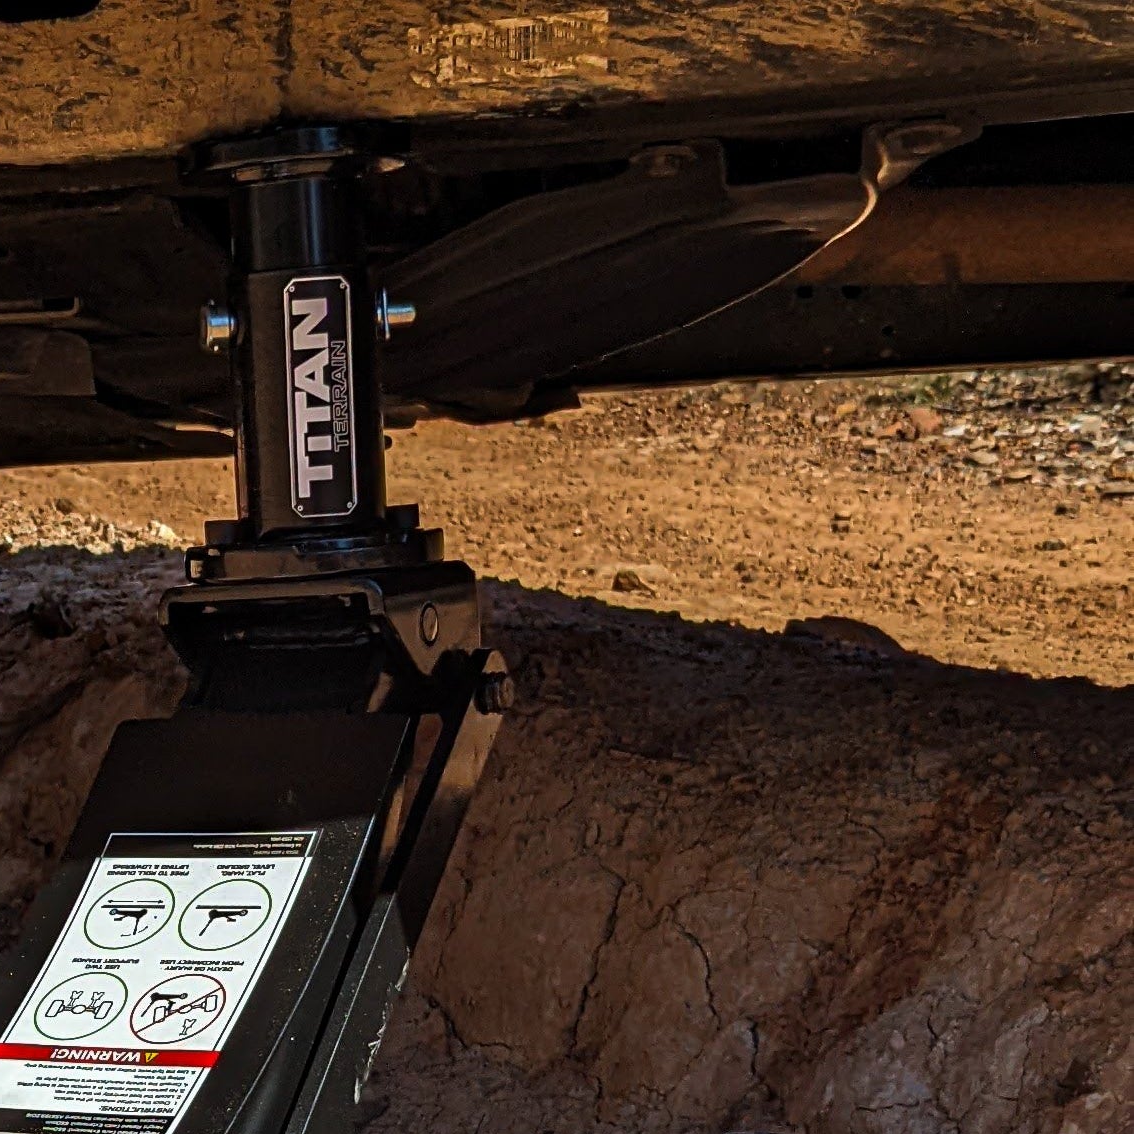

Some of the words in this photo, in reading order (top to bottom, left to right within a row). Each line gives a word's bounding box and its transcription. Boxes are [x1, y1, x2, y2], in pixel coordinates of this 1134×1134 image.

[292, 298, 333, 497] TITAN
[331, 340, 348, 452] TERRAIN
[50, 1048, 141, 1062] WARNING!
